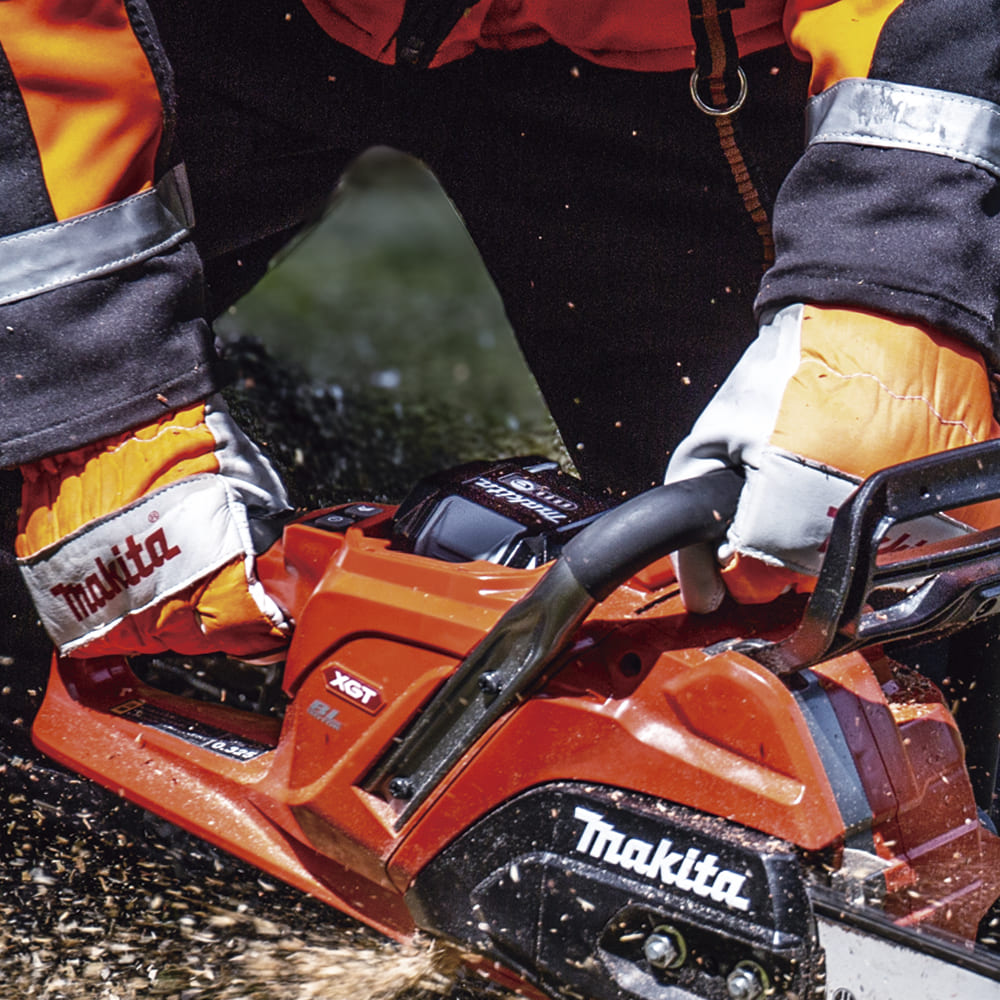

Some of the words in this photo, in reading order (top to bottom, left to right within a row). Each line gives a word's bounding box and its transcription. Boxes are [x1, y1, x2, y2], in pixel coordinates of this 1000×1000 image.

[50, 527, 182, 622] Makita
[329, 670, 377, 704] XGT
[573, 806, 751, 911] Makita
